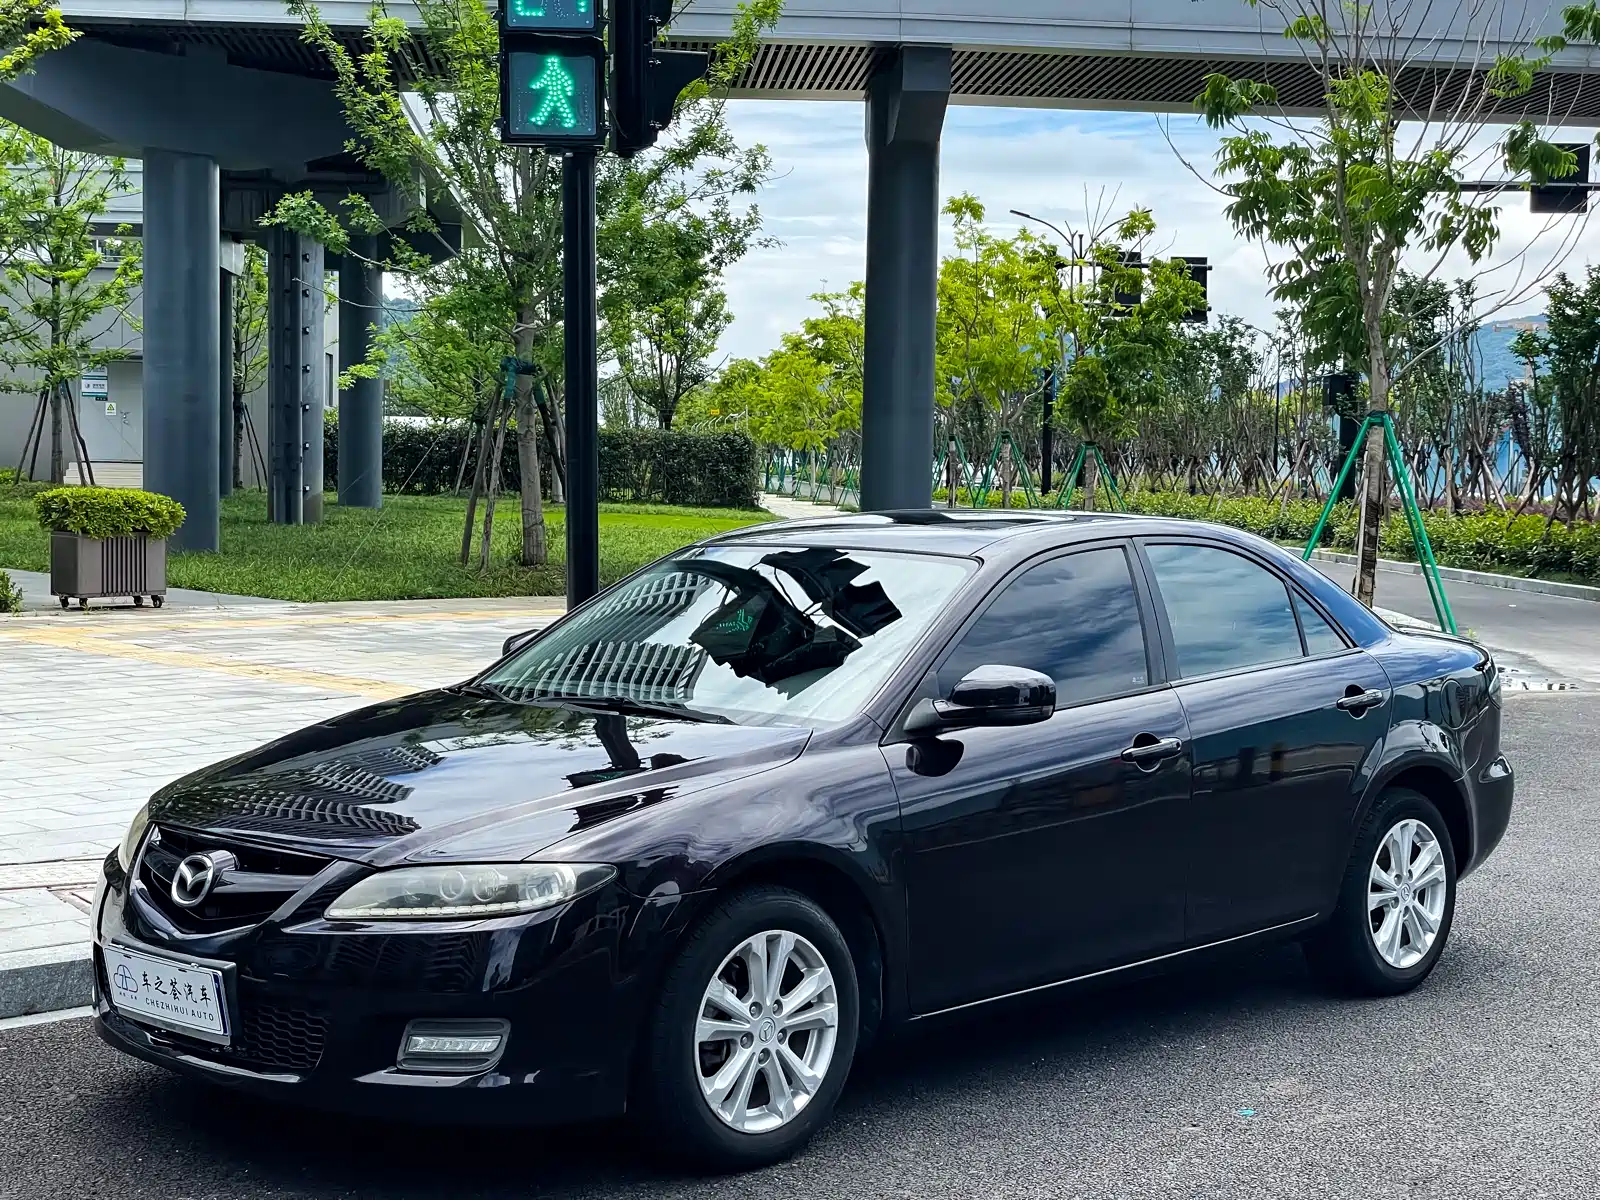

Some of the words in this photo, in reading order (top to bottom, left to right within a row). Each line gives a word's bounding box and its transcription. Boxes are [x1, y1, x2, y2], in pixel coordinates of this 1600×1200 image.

[142, 971, 212, 1007] 车之荟汽车
[145, 997, 189, 1016] CHEZHIHUI
[191, 1009, 214, 1021] AUTO
